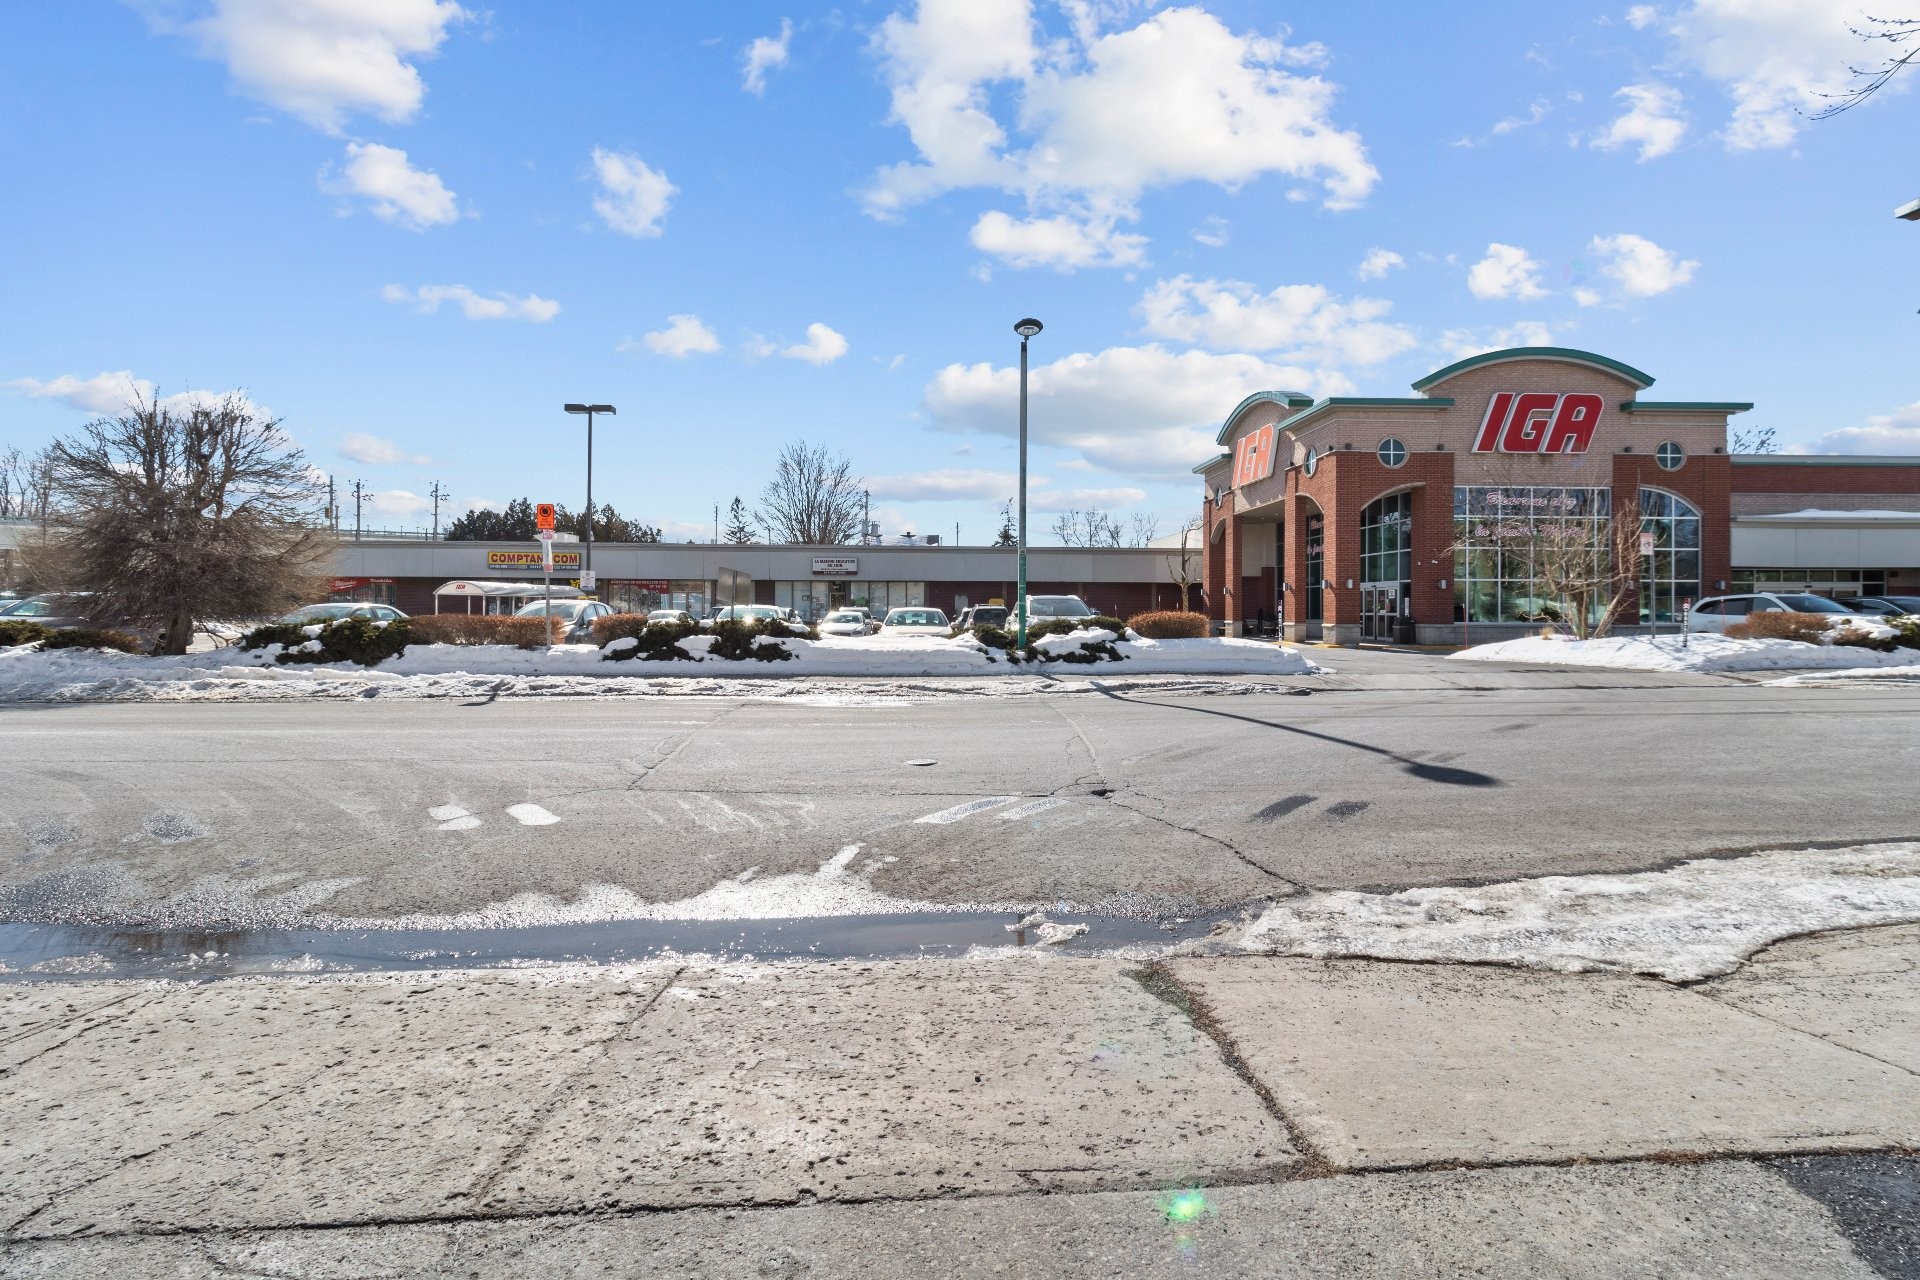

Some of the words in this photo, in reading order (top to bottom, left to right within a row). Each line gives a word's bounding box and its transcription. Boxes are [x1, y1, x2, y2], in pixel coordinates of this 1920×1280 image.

[1471, 391, 1605, 455] IGA
[1231, 423, 1277, 489] IGA
[490, 553, 579, 565] COMPTANCOM
